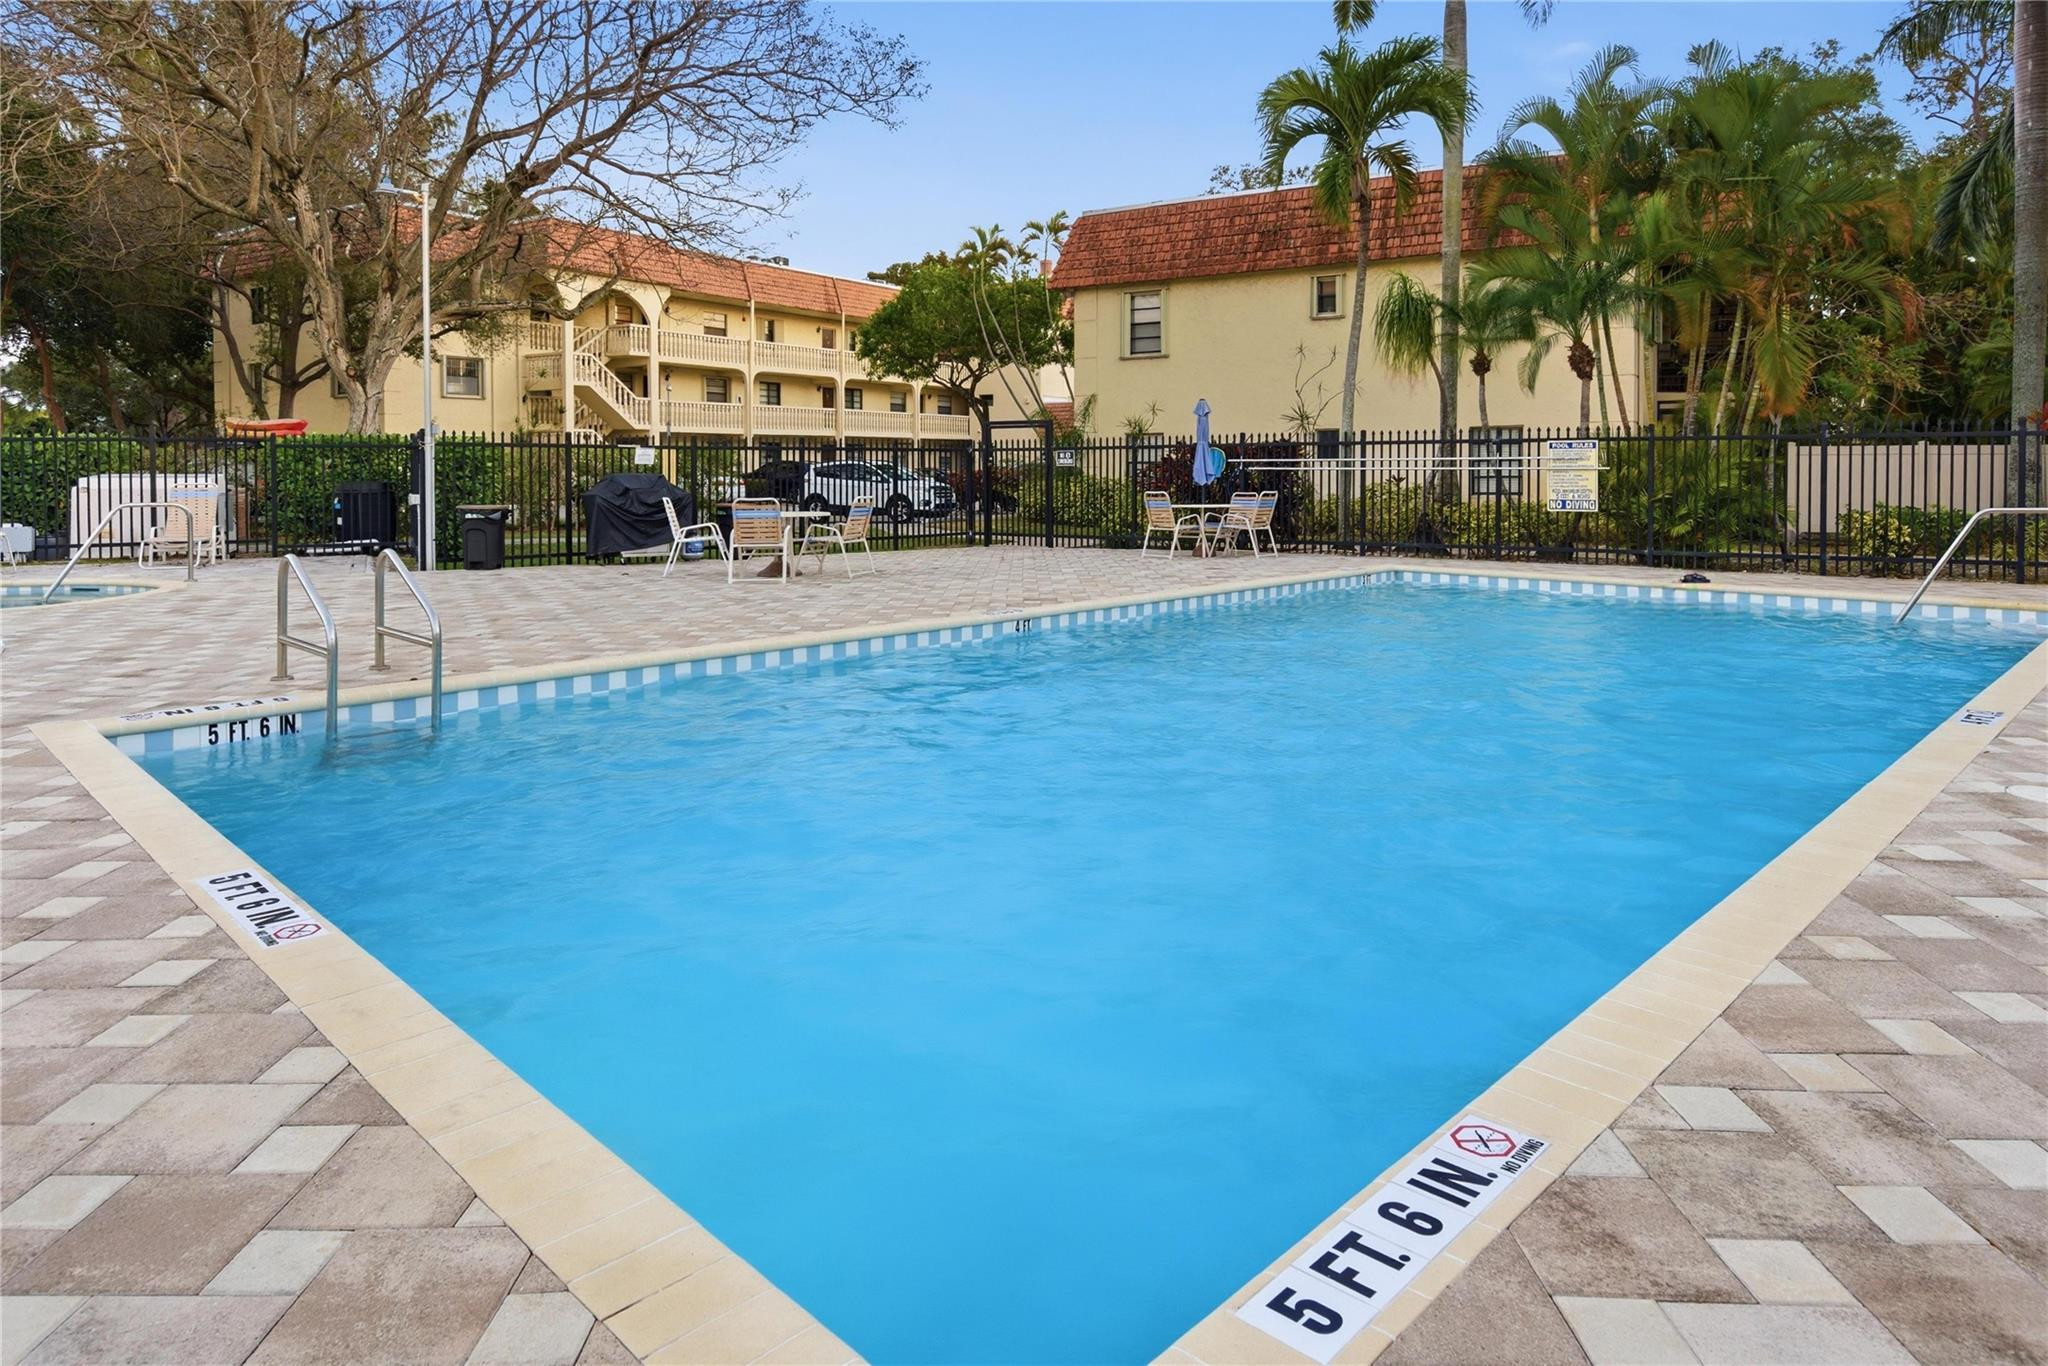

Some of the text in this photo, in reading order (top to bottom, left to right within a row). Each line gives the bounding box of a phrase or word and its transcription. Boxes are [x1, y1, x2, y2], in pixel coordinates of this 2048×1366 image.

[1550, 500, 1595, 510] NO DIVING
[1015, 620, 1020, 632] 4
[208, 714, 300, 746] 5 FT. 6 IN.
[208, 872, 300, 929] 5 FT. 6 IN.
[1500, 1138, 1545, 1174] NO DIVING
[1265, 1157, 1499, 1335] 5 FT. 6 IN.
